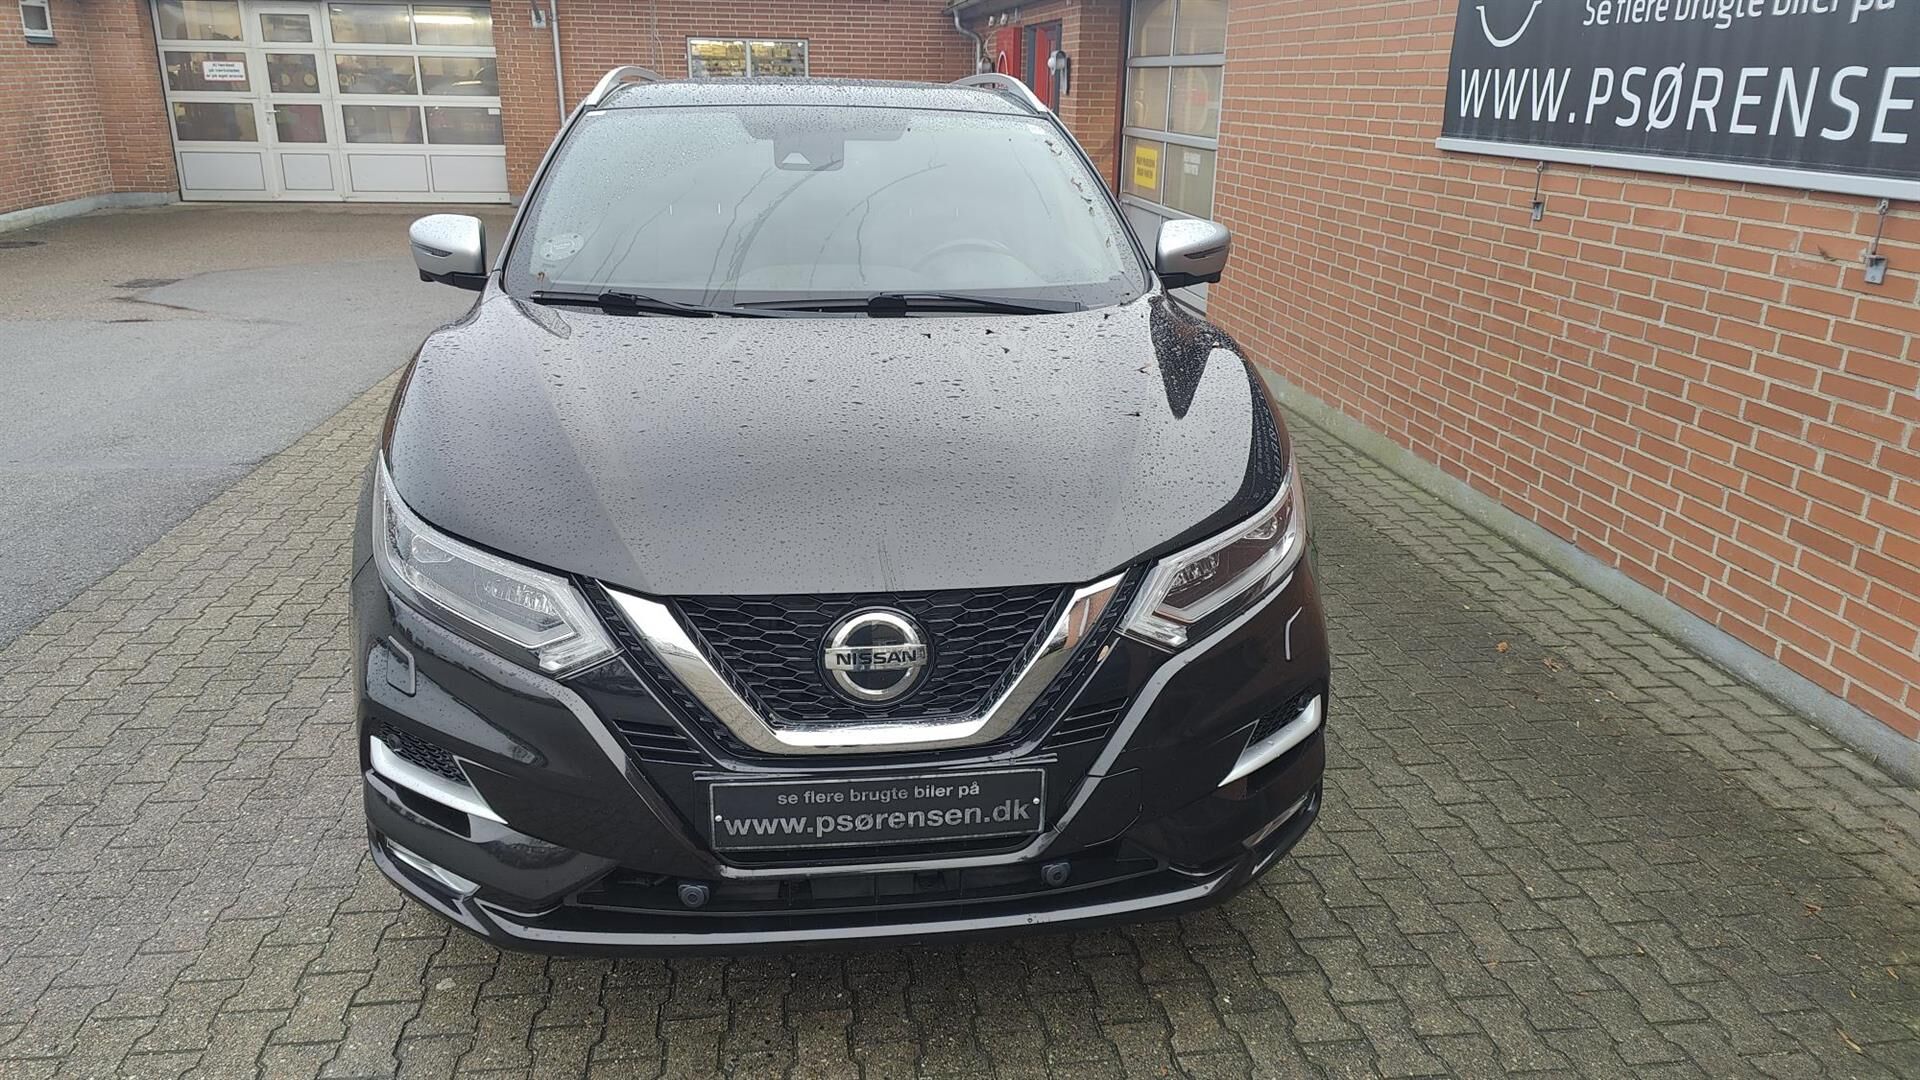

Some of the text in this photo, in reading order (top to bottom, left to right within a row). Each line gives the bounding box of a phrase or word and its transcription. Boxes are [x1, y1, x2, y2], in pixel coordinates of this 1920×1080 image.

[1583, 0, 1612, 26] Se
[1459, 62, 1920, 144] WWW.PSØRENSE
[836, 650, 917, 665] NISSAN
[777, 781, 980, 805] se flere brugte biler på
[724, 799, 1030, 838] www.psørensen.dk
